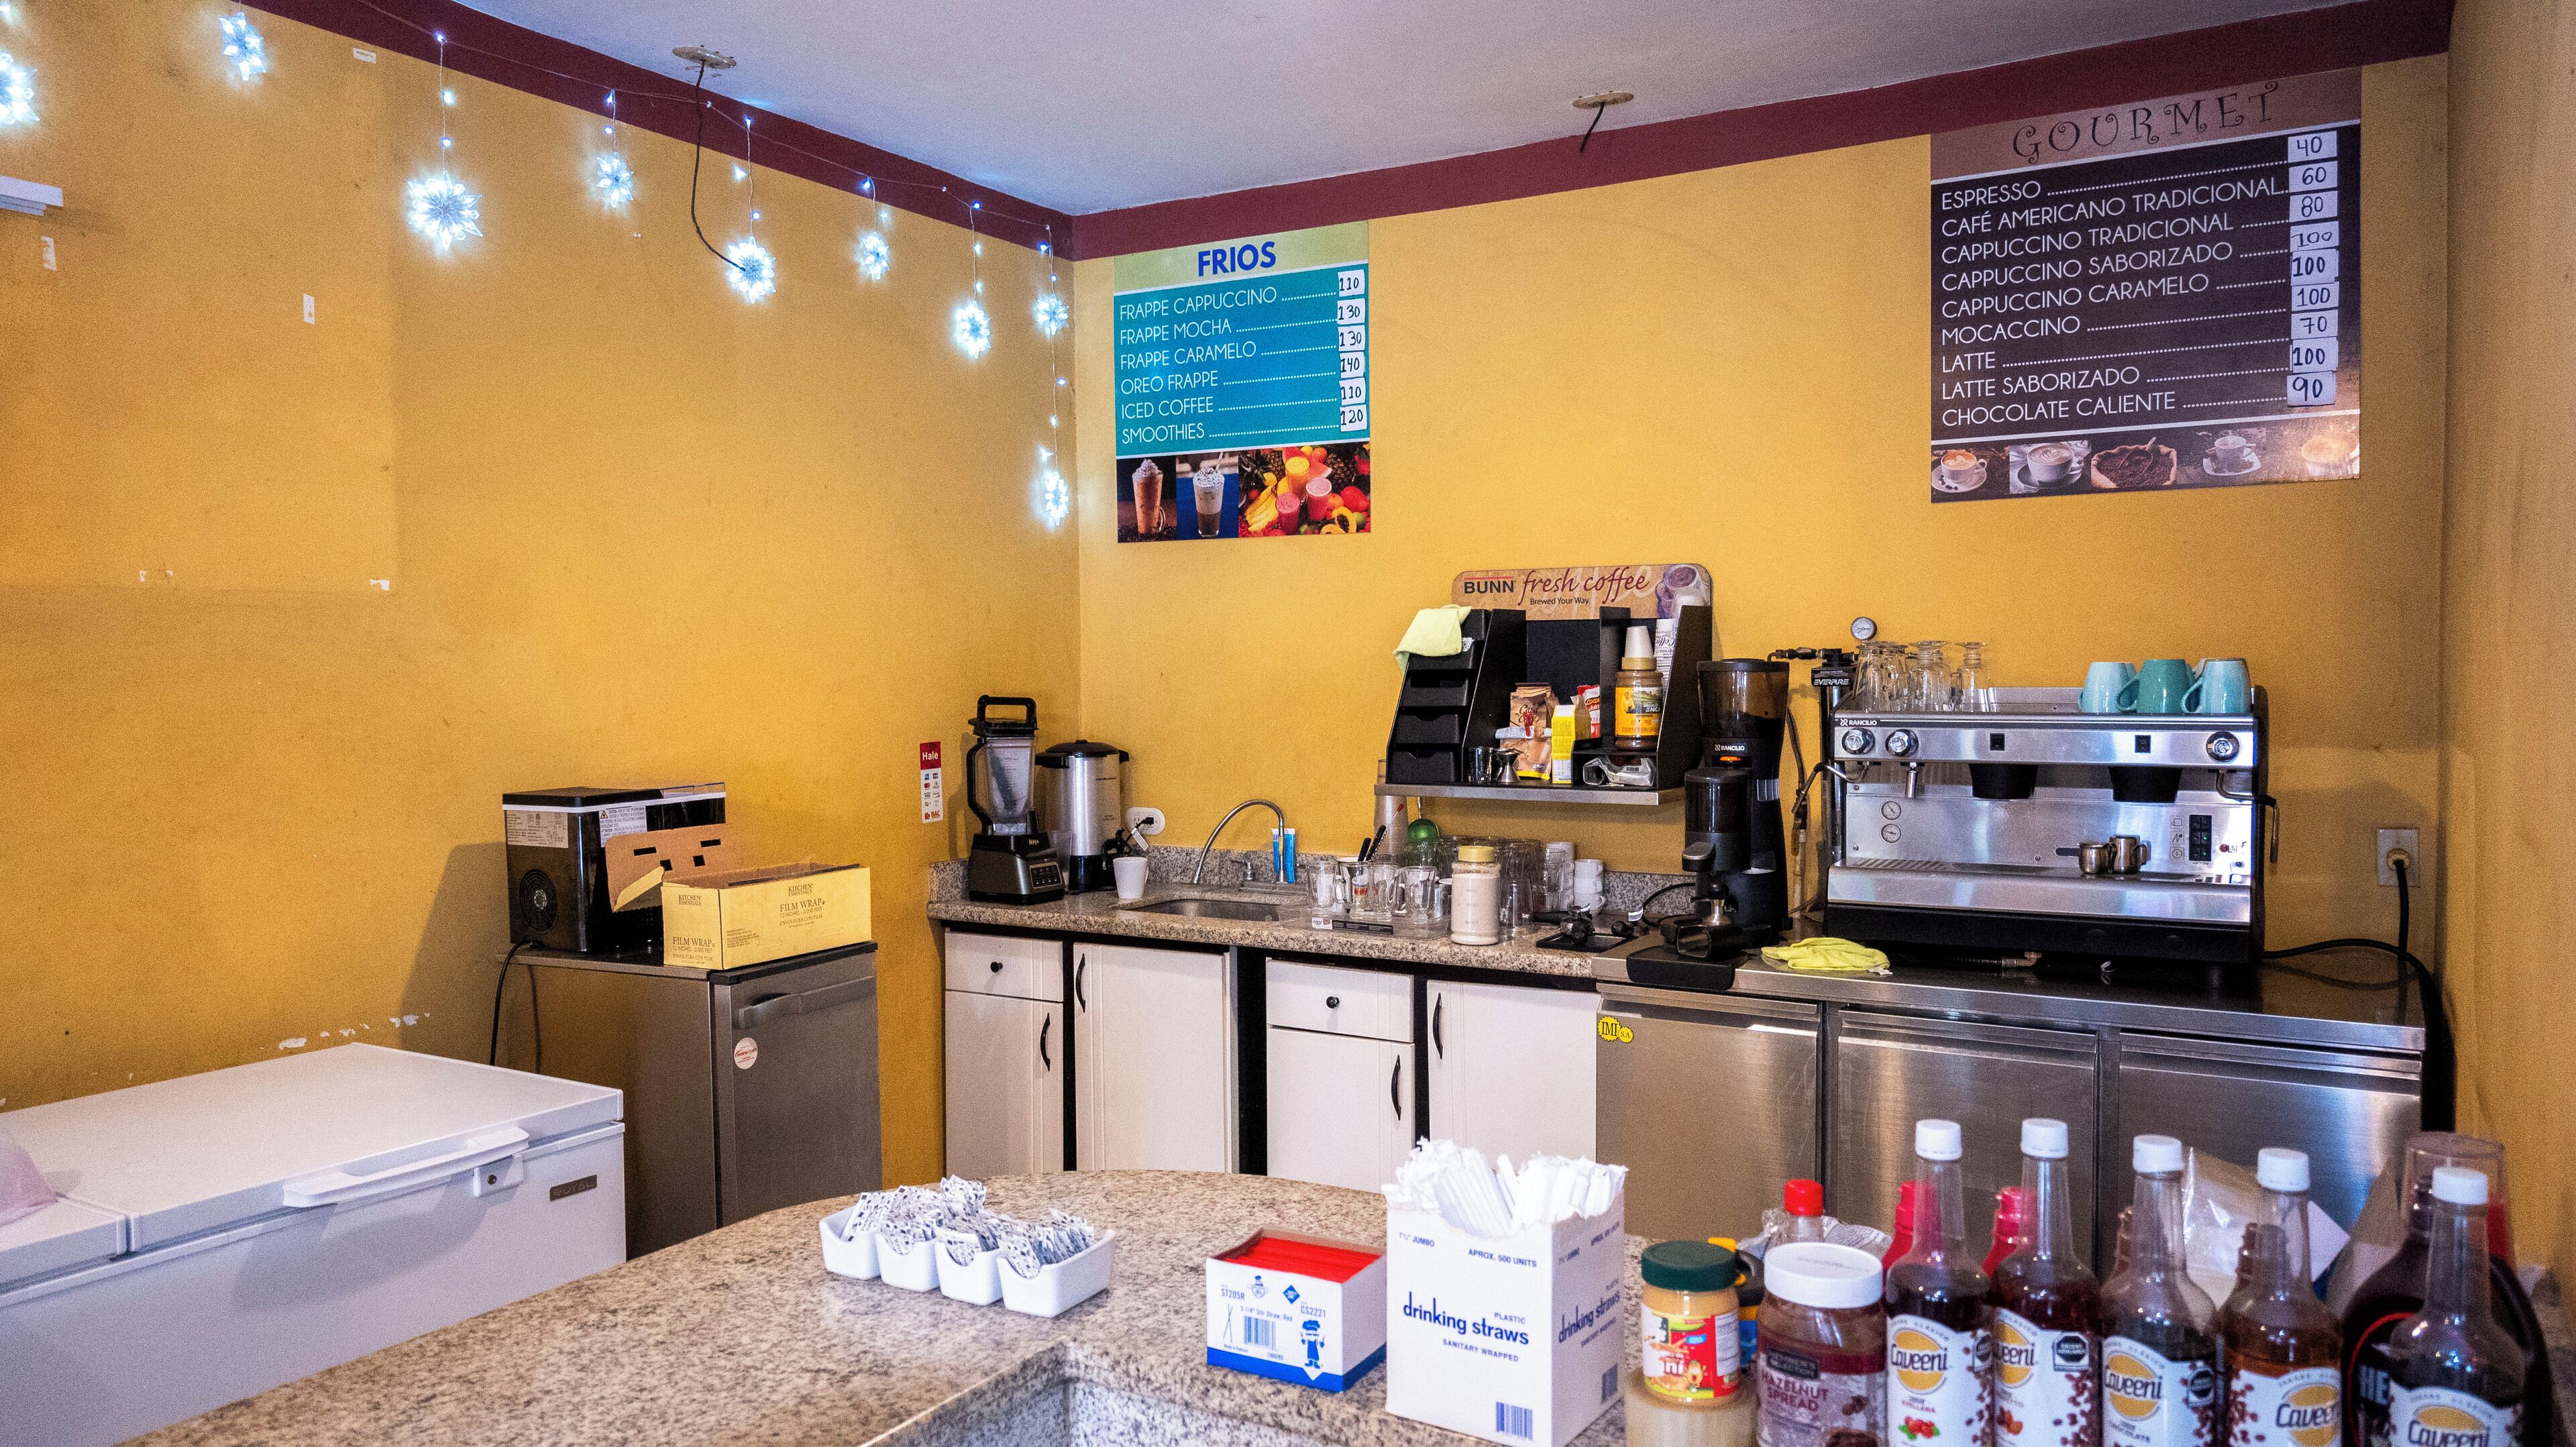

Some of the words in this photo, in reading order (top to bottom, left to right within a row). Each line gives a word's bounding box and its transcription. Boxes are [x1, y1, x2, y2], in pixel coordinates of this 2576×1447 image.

[2012, 81, 2279, 164] GOURMET
[2297, 136, 2322, 154] 40
[2302, 167, 2327, 184] 60
[1942, 181, 2041, 210] ESPRESSO
[1942, 211, 1991, 237] CAFÉ
[1998, 197, 2125, 230] AMERICANO
[2133, 178, 2282, 213] TRADICIONAL
[2300, 197, 2324, 217] 80
[1942, 231, 2082, 265] CAPPUCCINO
[2088, 213, 2234, 246] TRADICIONAL
[2292, 231, 2333, 248] 100
[1198, 242, 1276, 276] FRIOS
[1942, 259, 2082, 291] CAPPUCCINO
[2089, 242, 2233, 275] SABORIZADO
[2292, 258, 2326, 278] 100
[1339, 277, 1360, 292] 110
[1120, 299, 1169, 321] FRAPPE
[1174, 286, 1277, 315] CAPPUCCINO
[1942, 288, 2082, 319] CAPPUCCINO
[2089, 274, 2208, 303] CARAMELO
[2296, 287, 2331, 307] 100
[1338, 306, 1360, 321] 130
[1120, 325, 1169, 345] FRAPPE
[1174, 318, 1232, 339] MOCHA
[1942, 315, 2080, 345] MOCACCINO
[2300, 317, 2328, 335] 70
[1339, 331, 1362, 347] 130
[1120, 350, 1169, 370] FRAPPE
[1175, 341, 1256, 365] CARAMELO
[1340, 358, 1360, 373] 140
[1942, 352, 1996, 374] LATTE
[2292, 347, 2326, 366] 100
[1121, 376, 1163, 395] OREO
[1168, 370, 1218, 390] FRAPPE
[1942, 379, 1996, 400] LATTE
[2003, 366, 2139, 396] SABORIZADO
[2292, 378, 2323, 403] 90
[1340, 386, 1362, 401] 110
[1122, 403, 1154, 419] ICED
[1159, 396, 1214, 416] COFFEE
[1942, 400, 2069, 427] CHOCOLATE
[2076, 392, 2176, 416] CALIENTE
[1340, 411, 1364, 426] 120
[1122, 423, 1205, 444] SMOOTHIES
[1464, 580, 1514, 594] BUNN
[1517, 568, 1579, 606] fresh
[1584, 567, 1650, 604] coffee
[1558, 597, 1574, 605] Your
[1575, 598, 1589, 606] Way
[922, 751, 938, 761] Hale
[788, 883, 812, 892] KITCHEN
[780, 902, 798, 912] FILM
[800, 898, 822, 908] WRAP
[673, 936, 690, 946] FILM
[692, 938, 712, 947] WRAP
[1601, 1022, 1618, 1036] IMI
[553, 1179, 595, 1196] ROYAL
[1412, 1236, 1435, 1247] JUMBO
[1468, 1249, 1495, 1261] APROX.
[1498, 1255, 1511, 1263] 500
[1513, 1258, 1537, 1267] UNITS
[1221, 1288, 1245, 1300] ST205R
[1300, 1305, 1326, 1318] CS2221
[1403, 1291, 1466, 1334] drinking
[1472, 1318, 1529, 1345] straws
[1494, 1312, 1525, 1324] PLASTIC
[1558, 1305, 1594, 1343] drinking
[1596, 1290, 1621, 1318] straws
[1442, 1339, 1479, 1352] SANITARY
[1481, 1348, 1519, 1362] WRAPPED
[1891, 1344, 1948, 1371] Caveeni
[1762, 1370, 1829, 1401] HAZELNUT
[2106, 1365, 2162, 1399] Caveeni
[1767, 1386, 1819, 1411] SPREAD
